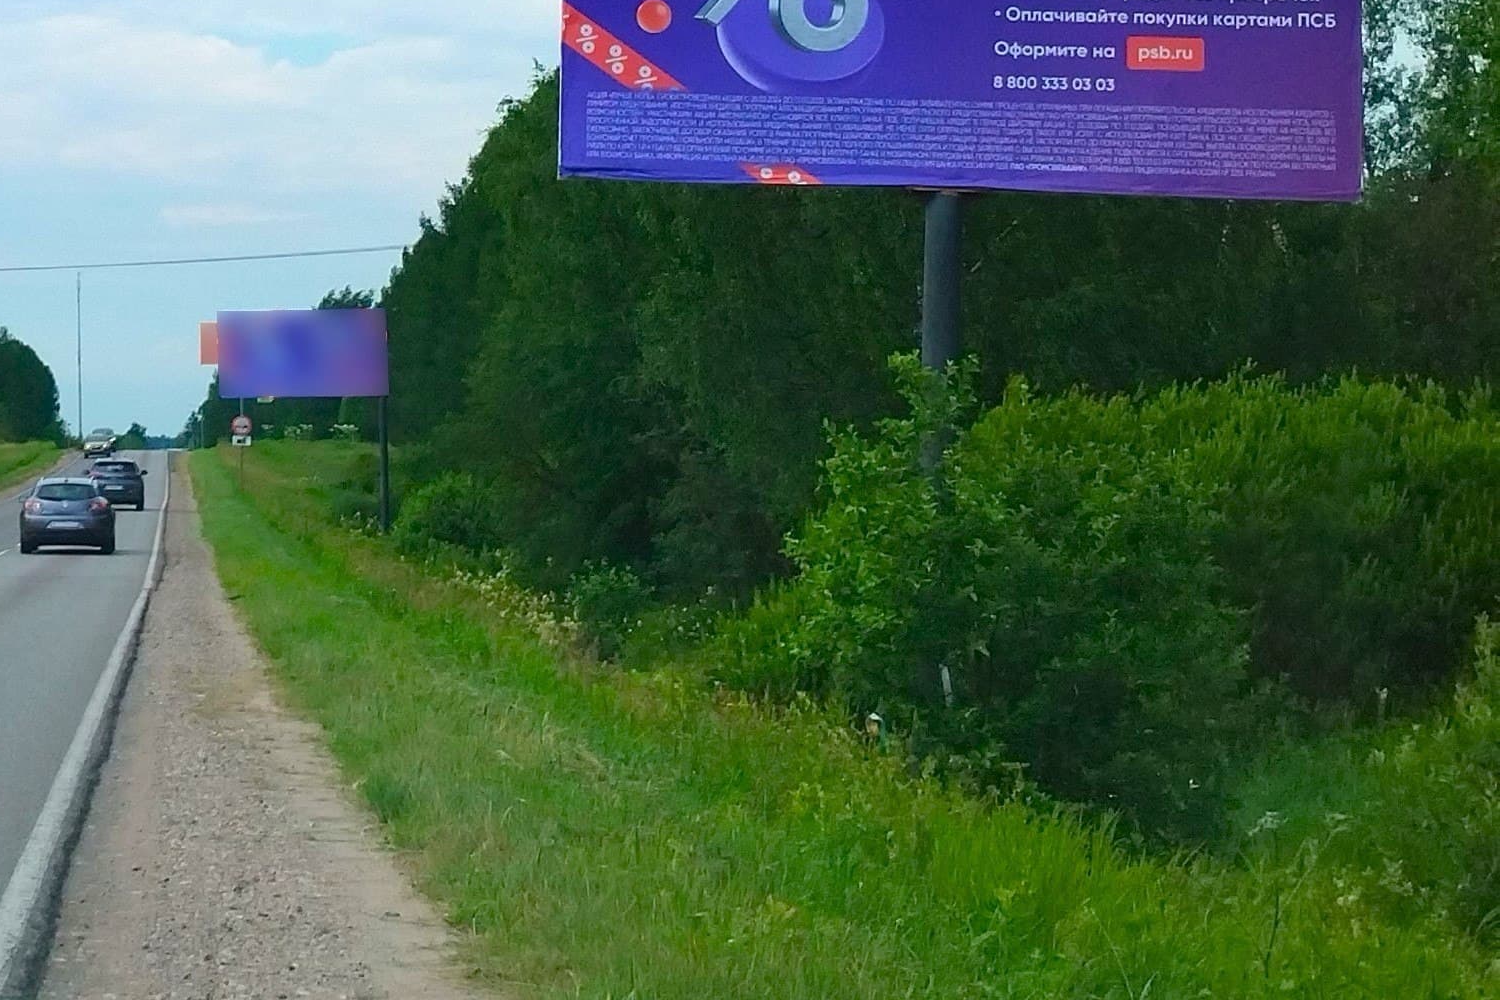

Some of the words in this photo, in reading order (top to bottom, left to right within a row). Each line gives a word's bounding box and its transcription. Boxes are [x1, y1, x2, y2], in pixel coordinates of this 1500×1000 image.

[1005, 6, 1129, 24] Оплачивайте
[1133, 12, 1208, 28] покупки
[1213, 14, 1293, 30] картами
[1297, 12, 1337, 28] ПСБ
[994, 40, 1088, 60] Оформите
[1092, 46, 1116, 58] на
[1138, 45, 1193, 63] psb.ru
[993, 75, 1004, 89] 8
[1006, 75, 1038, 90] 800
[1041, 76, 1069, 90] 333
[1072, 77, 1092, 91] 03
[1095, 78, 1116, 92] 03
